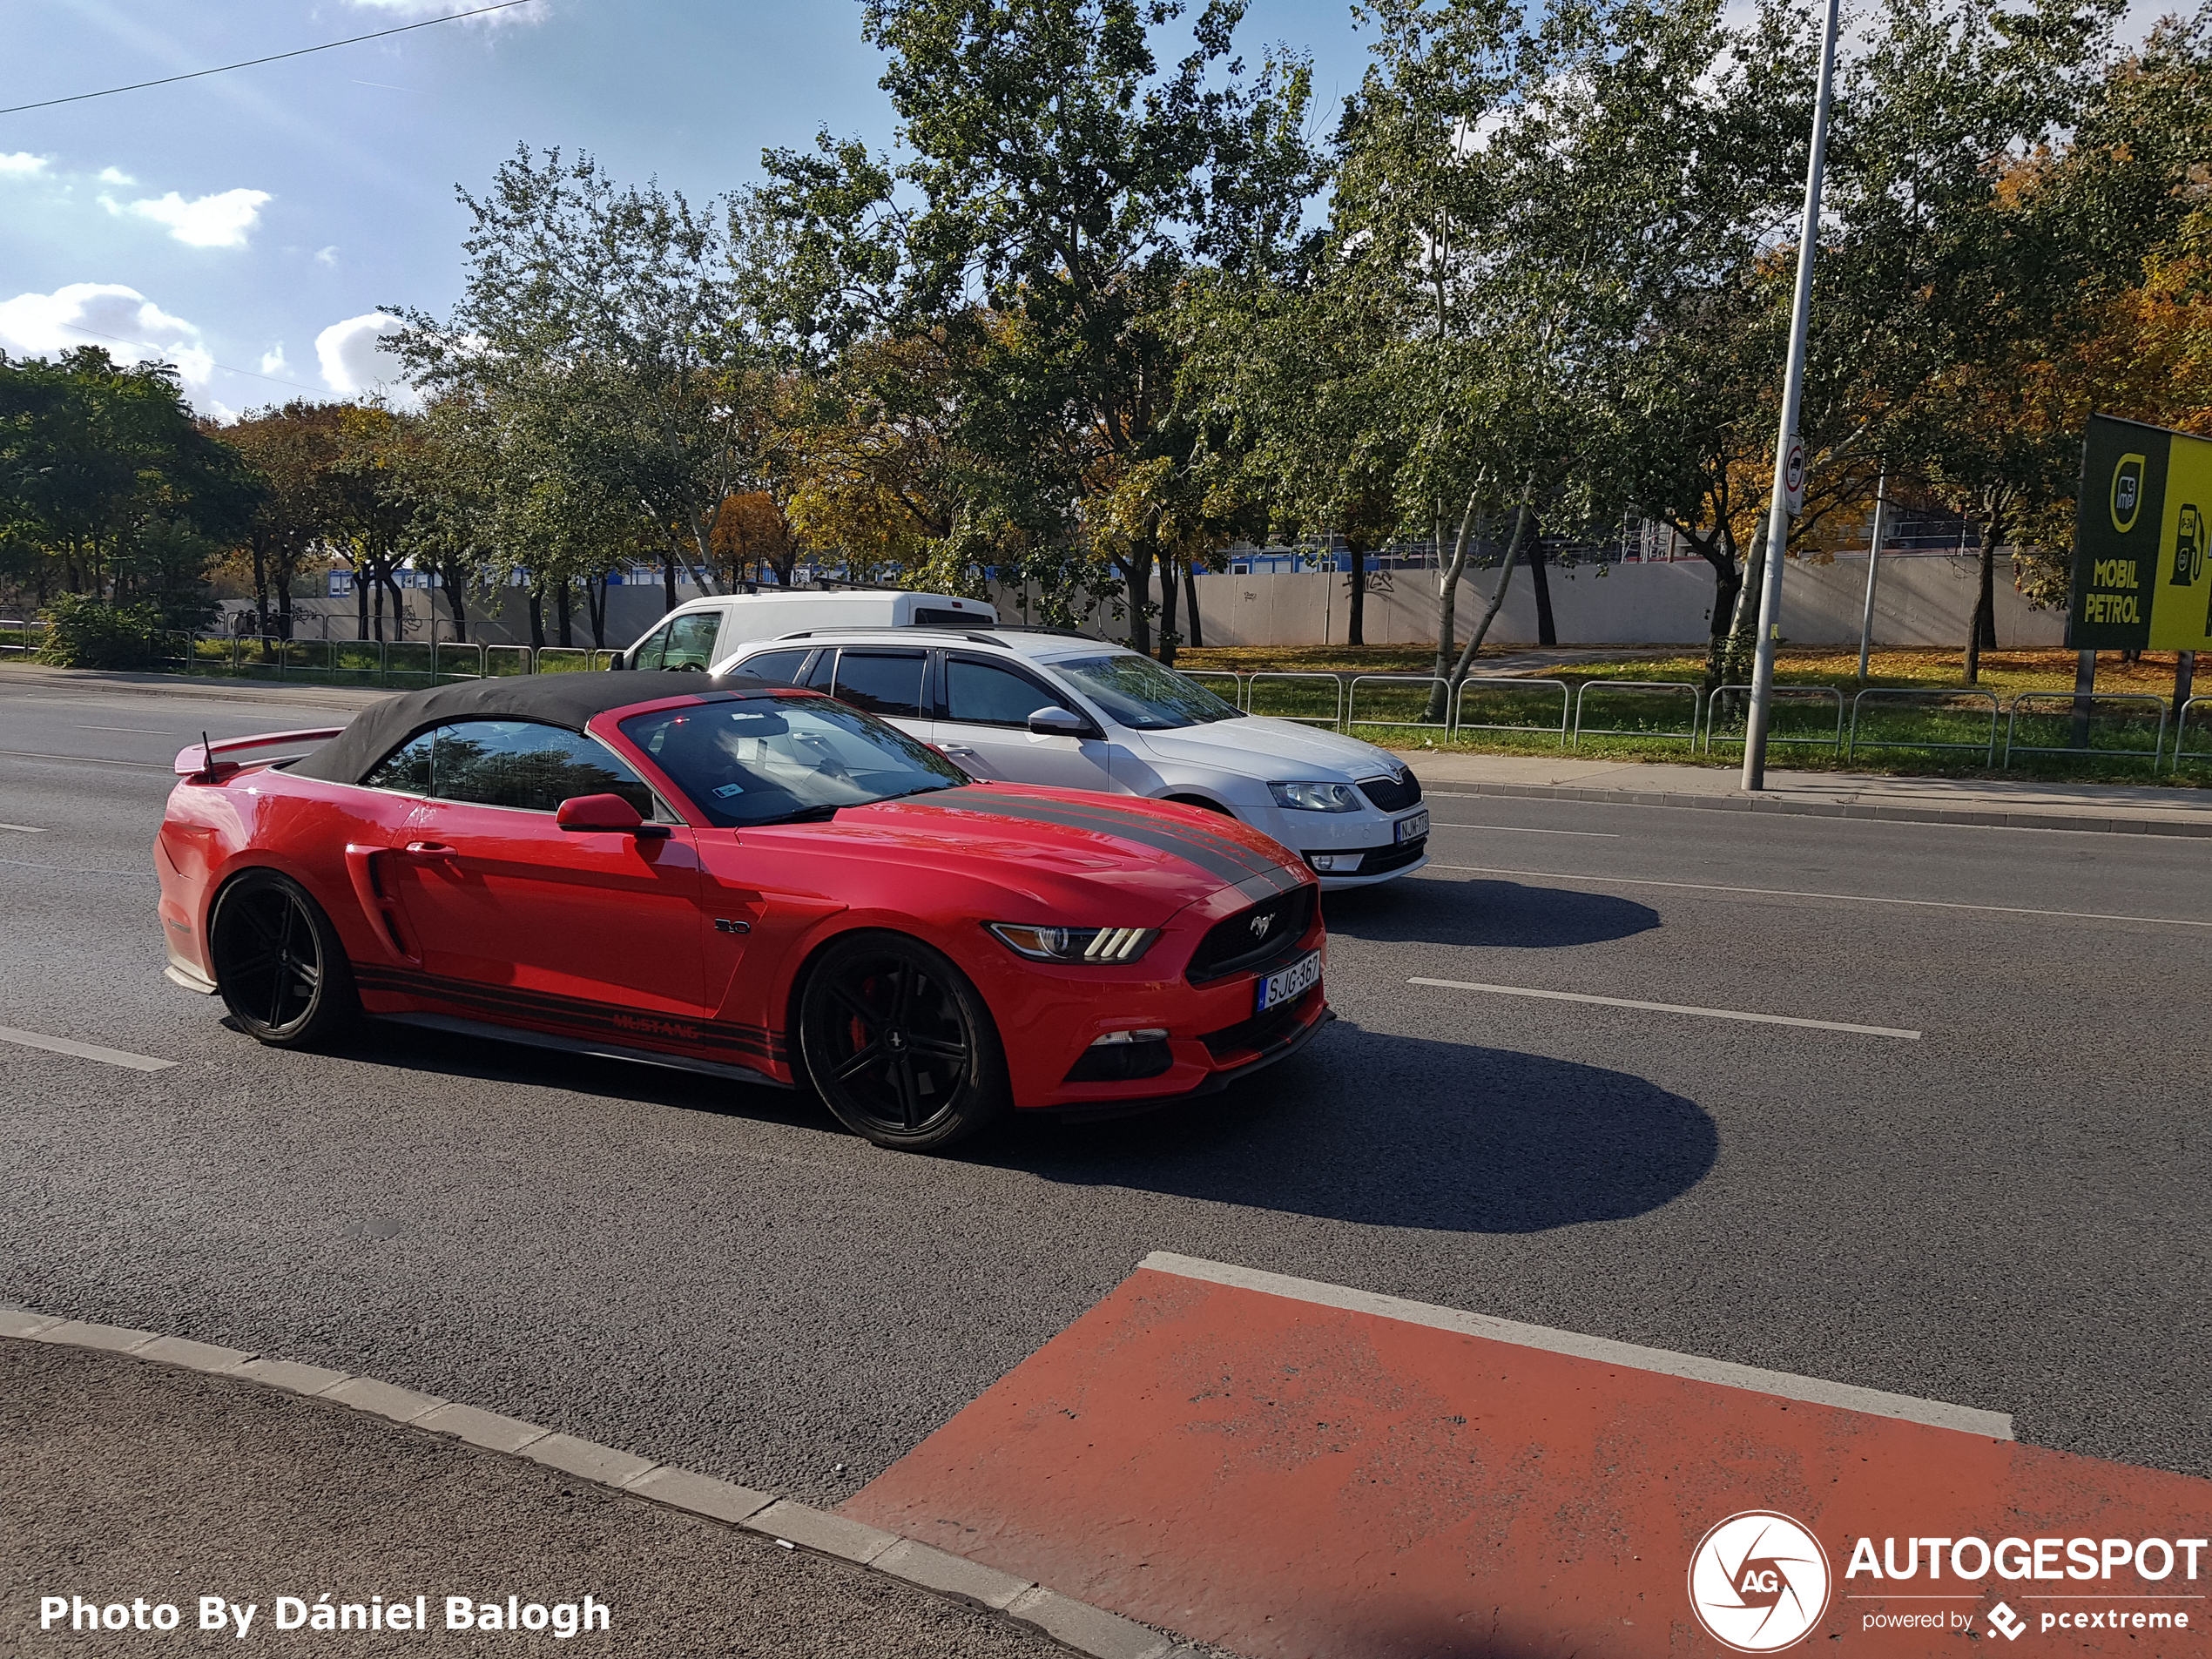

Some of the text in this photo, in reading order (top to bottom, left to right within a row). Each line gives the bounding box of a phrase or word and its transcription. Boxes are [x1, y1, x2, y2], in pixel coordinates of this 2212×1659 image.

[2093, 558, 2139, 590] MOBIL
[2084, 593, 2140, 624] PETROL
[714, 918, 751, 934] 5.0
[1269, 954, 1318, 1003] SJG-367
[612, 1015, 699, 1039] MUSTANG
